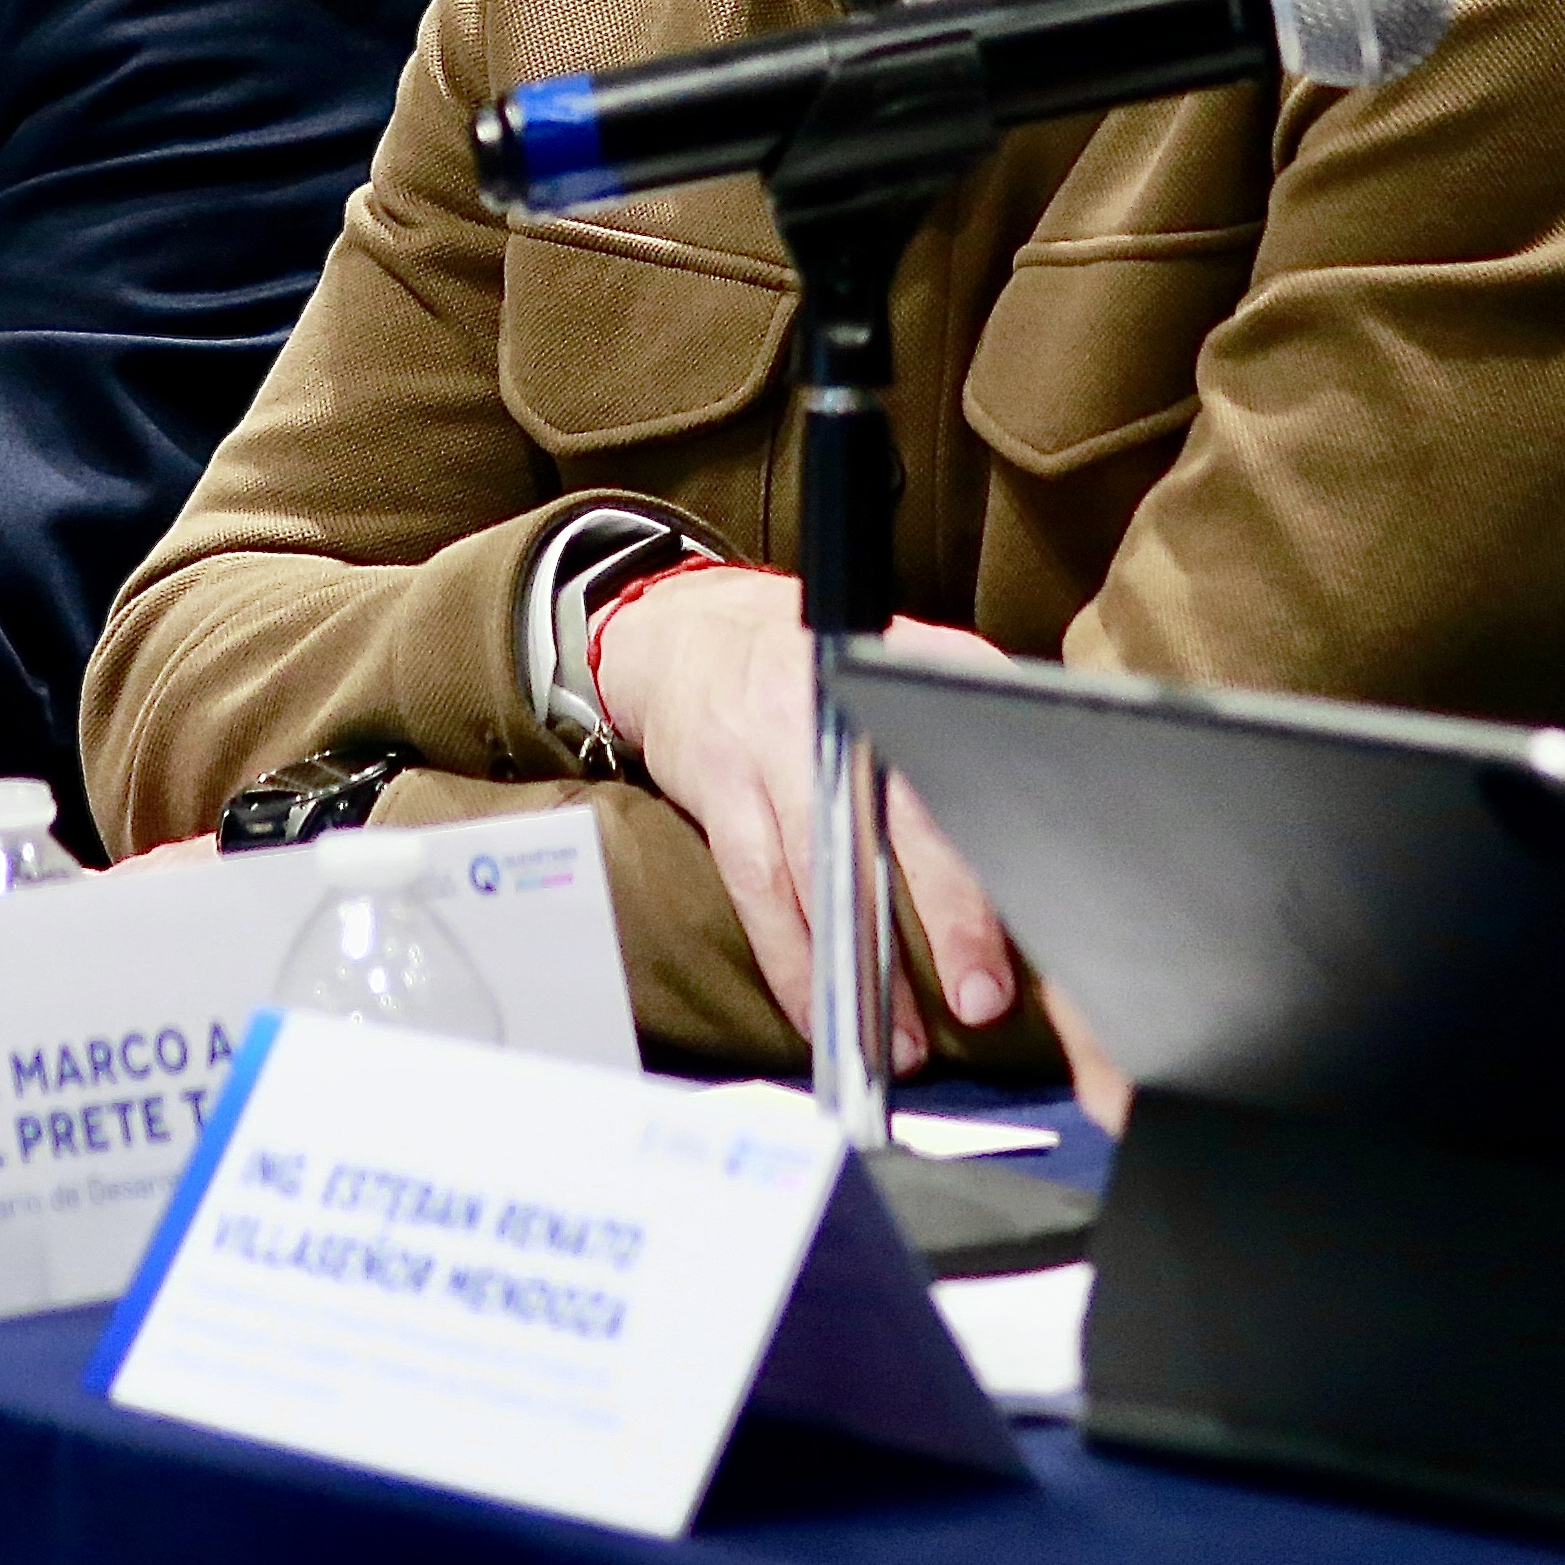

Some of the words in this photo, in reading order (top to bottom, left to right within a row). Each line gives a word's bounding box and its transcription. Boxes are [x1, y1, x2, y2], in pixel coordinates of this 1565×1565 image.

[8, 1028, 187, 1098] MARCO
[15, 1095, 172, 1164] PRETE
[50, 1187, 81, 1218] de
[321, 1163, 483, 1231] ESTEBAN
[497, 1199, 645, 1273] RENATO
